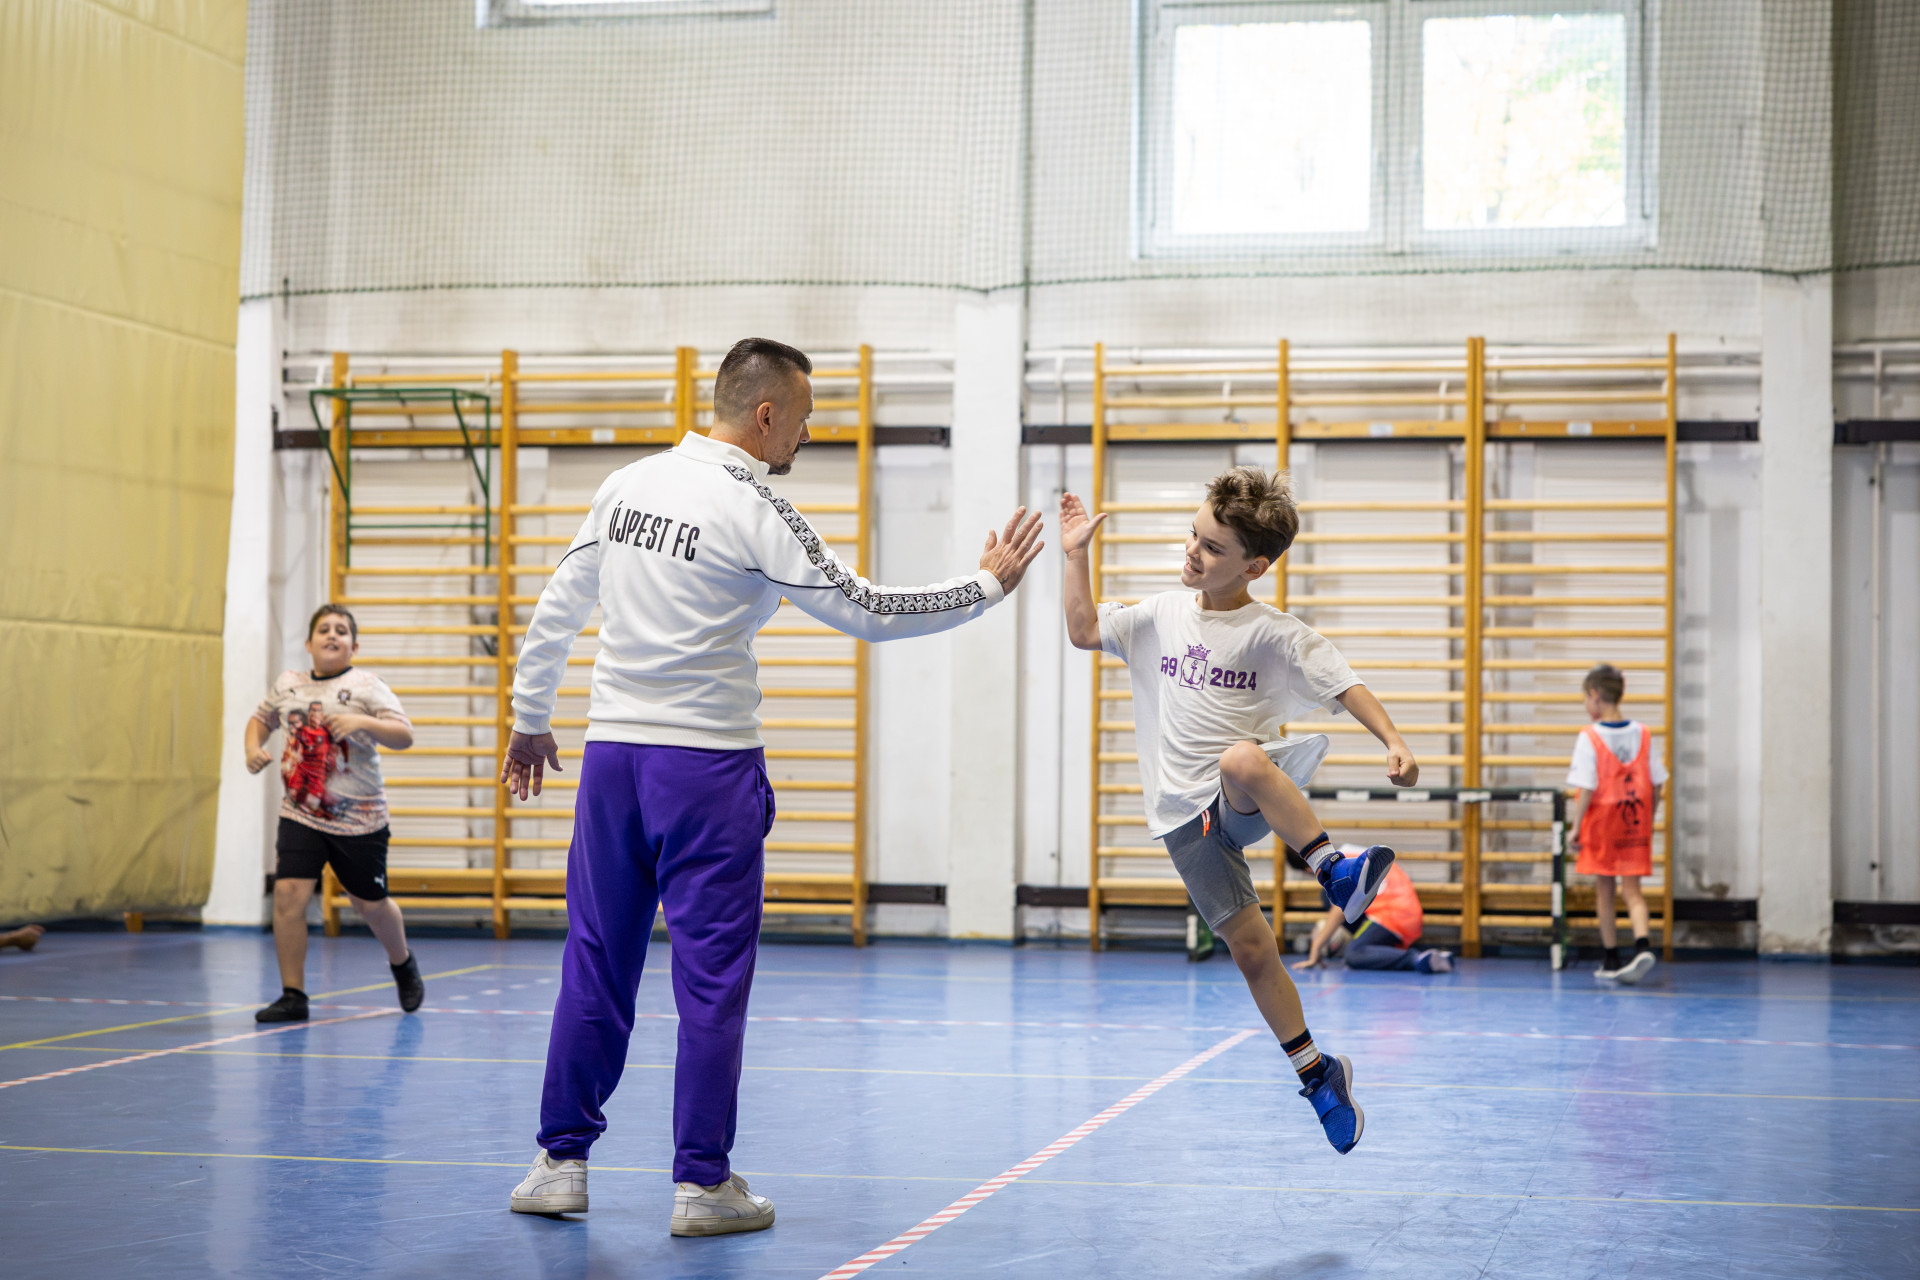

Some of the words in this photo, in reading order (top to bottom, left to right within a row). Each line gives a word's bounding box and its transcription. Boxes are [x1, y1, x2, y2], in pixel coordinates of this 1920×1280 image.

[609, 500, 674, 553] ÚJPEST
[672, 523, 700, 562] FC
[1209, 667, 1257, 691] 2024
